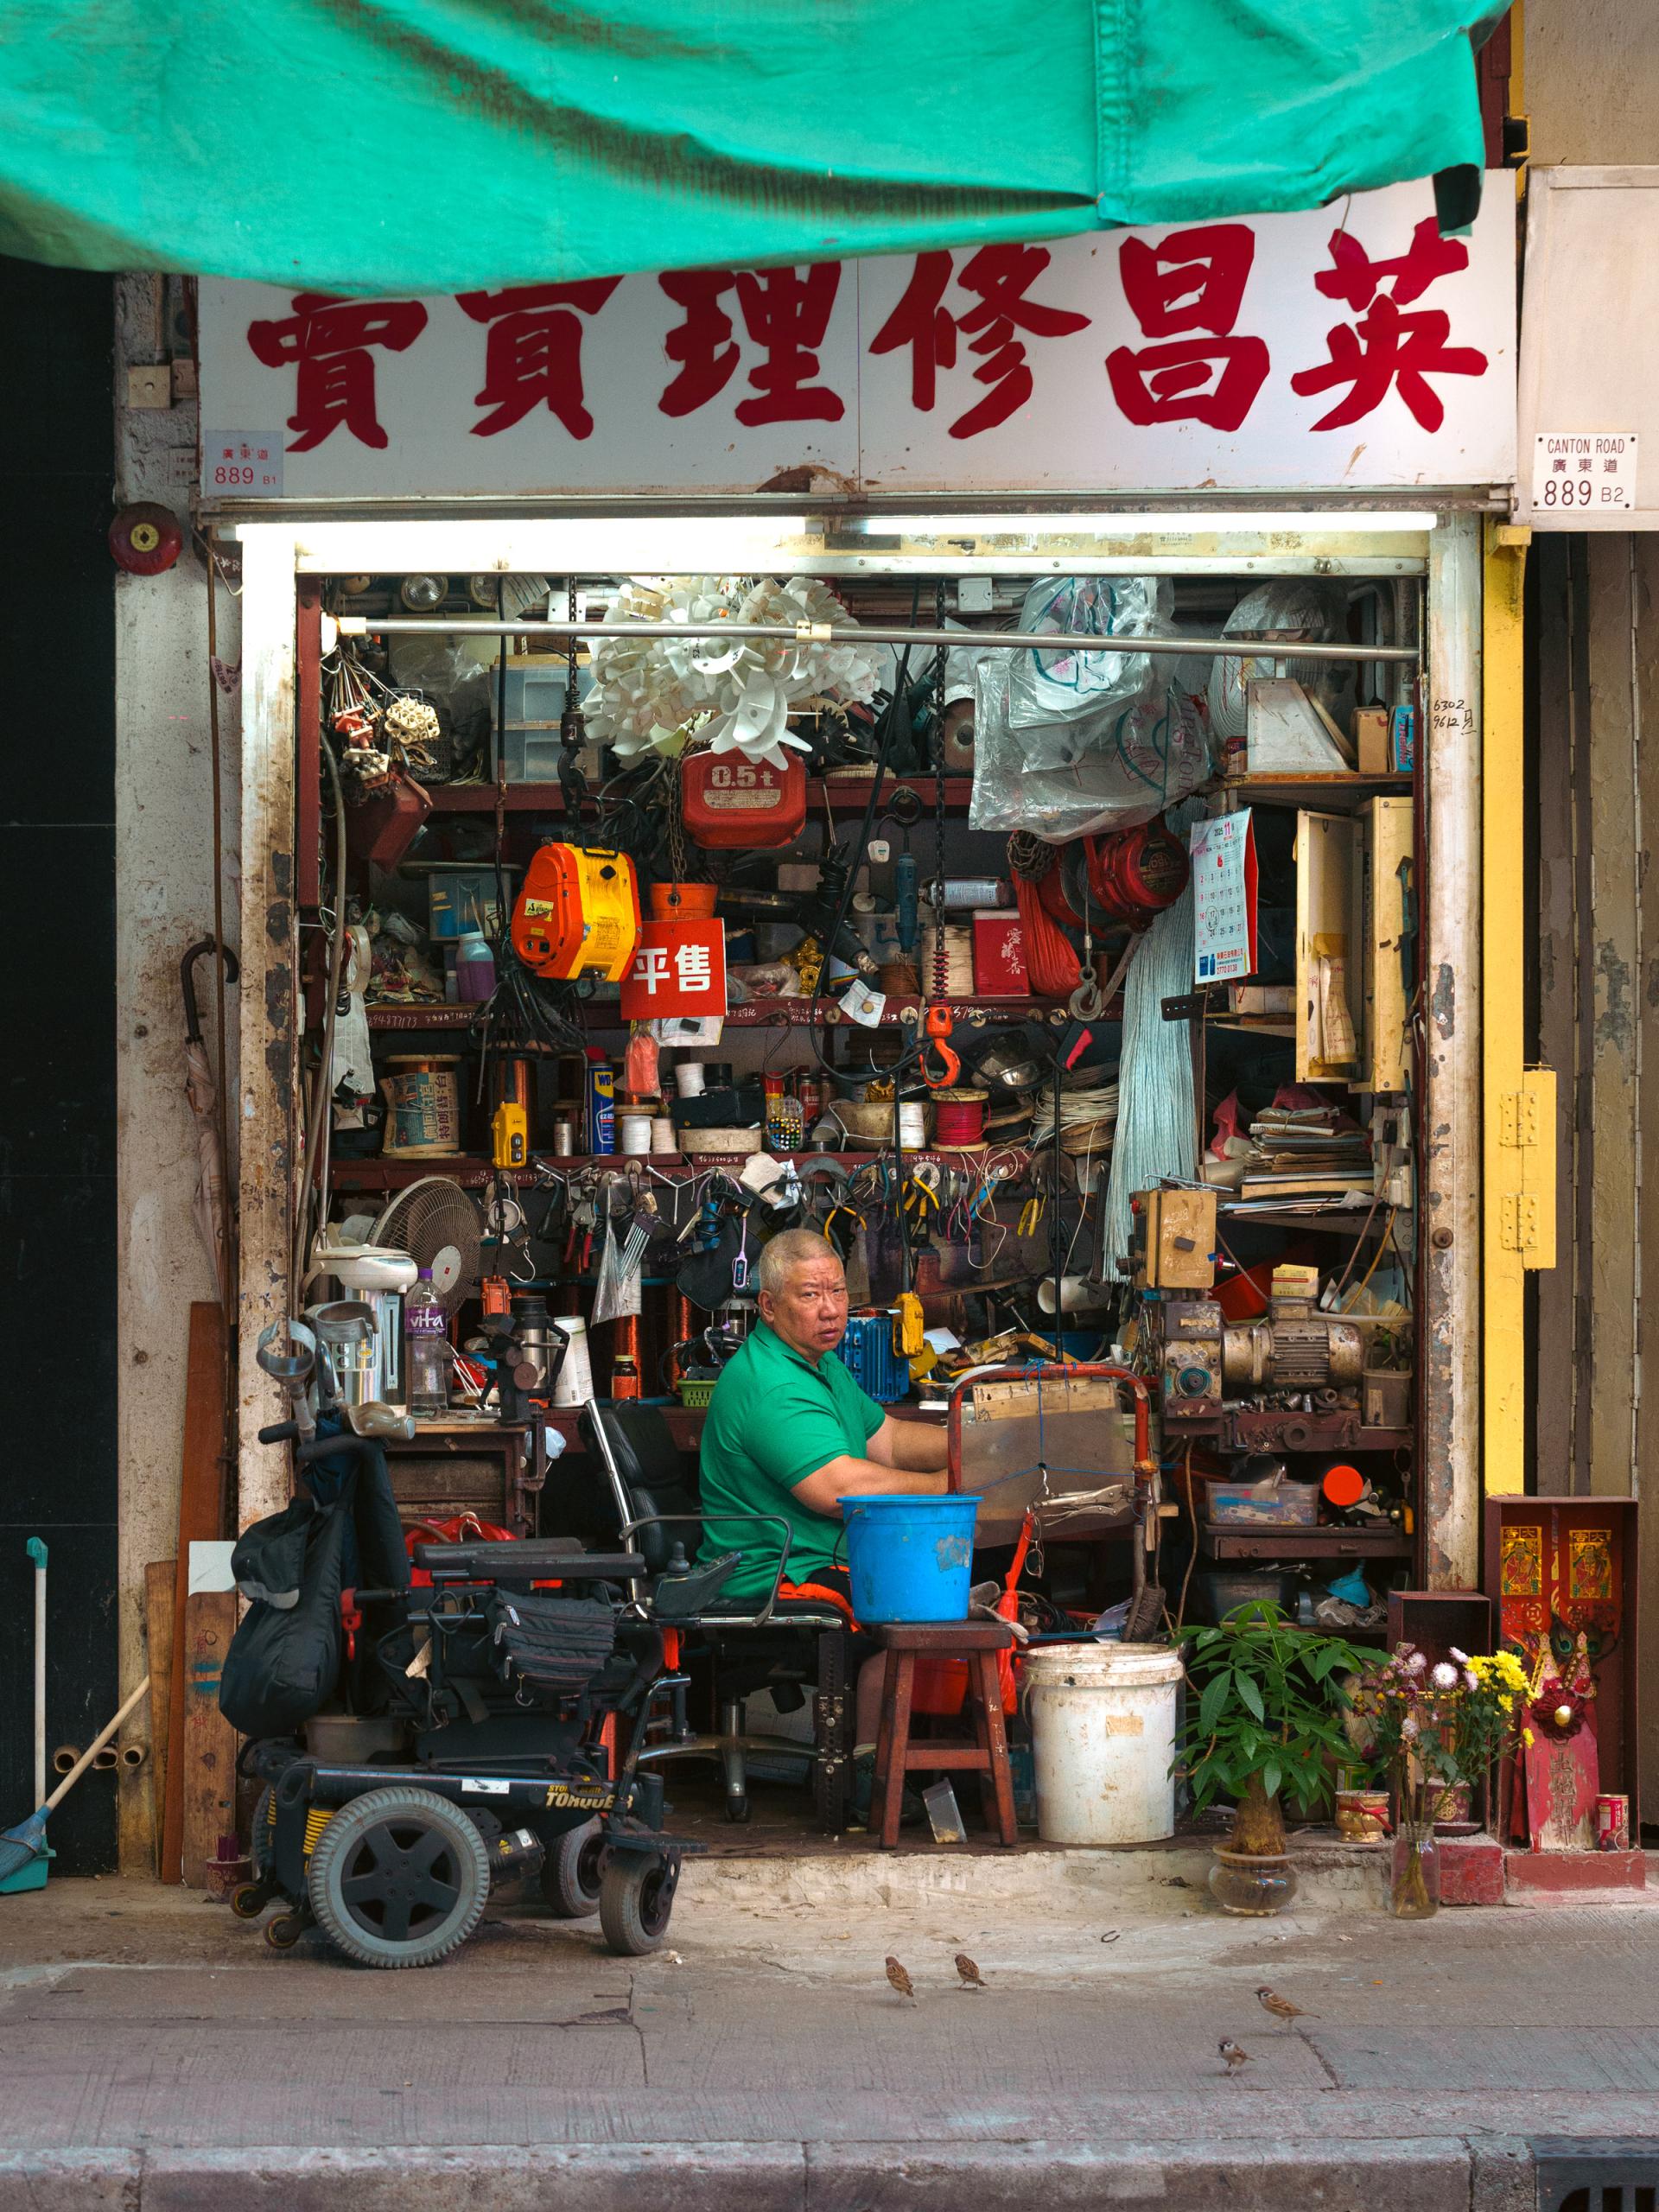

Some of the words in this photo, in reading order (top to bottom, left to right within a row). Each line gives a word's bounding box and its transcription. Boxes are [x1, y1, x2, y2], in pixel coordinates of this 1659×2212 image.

[1548, 438, 1591, 454] CANTON
[1596, 438, 1625, 454] ROAD
[1552, 458, 1618, 473] 廣東道
[214, 467, 254, 484] 889
[1544, 480, 1592, 505] 889
[1601, 486, 1624, 502] B2
[1433, 699, 1465, 711] 6302
[1433, 715, 1459, 729] 9612
[711, 766, 757, 788] 0.5
[760, 770, 774, 787] t
[633, 944, 711, 995] 平售
[410, 1307, 444, 1328] vita
[546, 1792, 615, 1810] TORQUE
